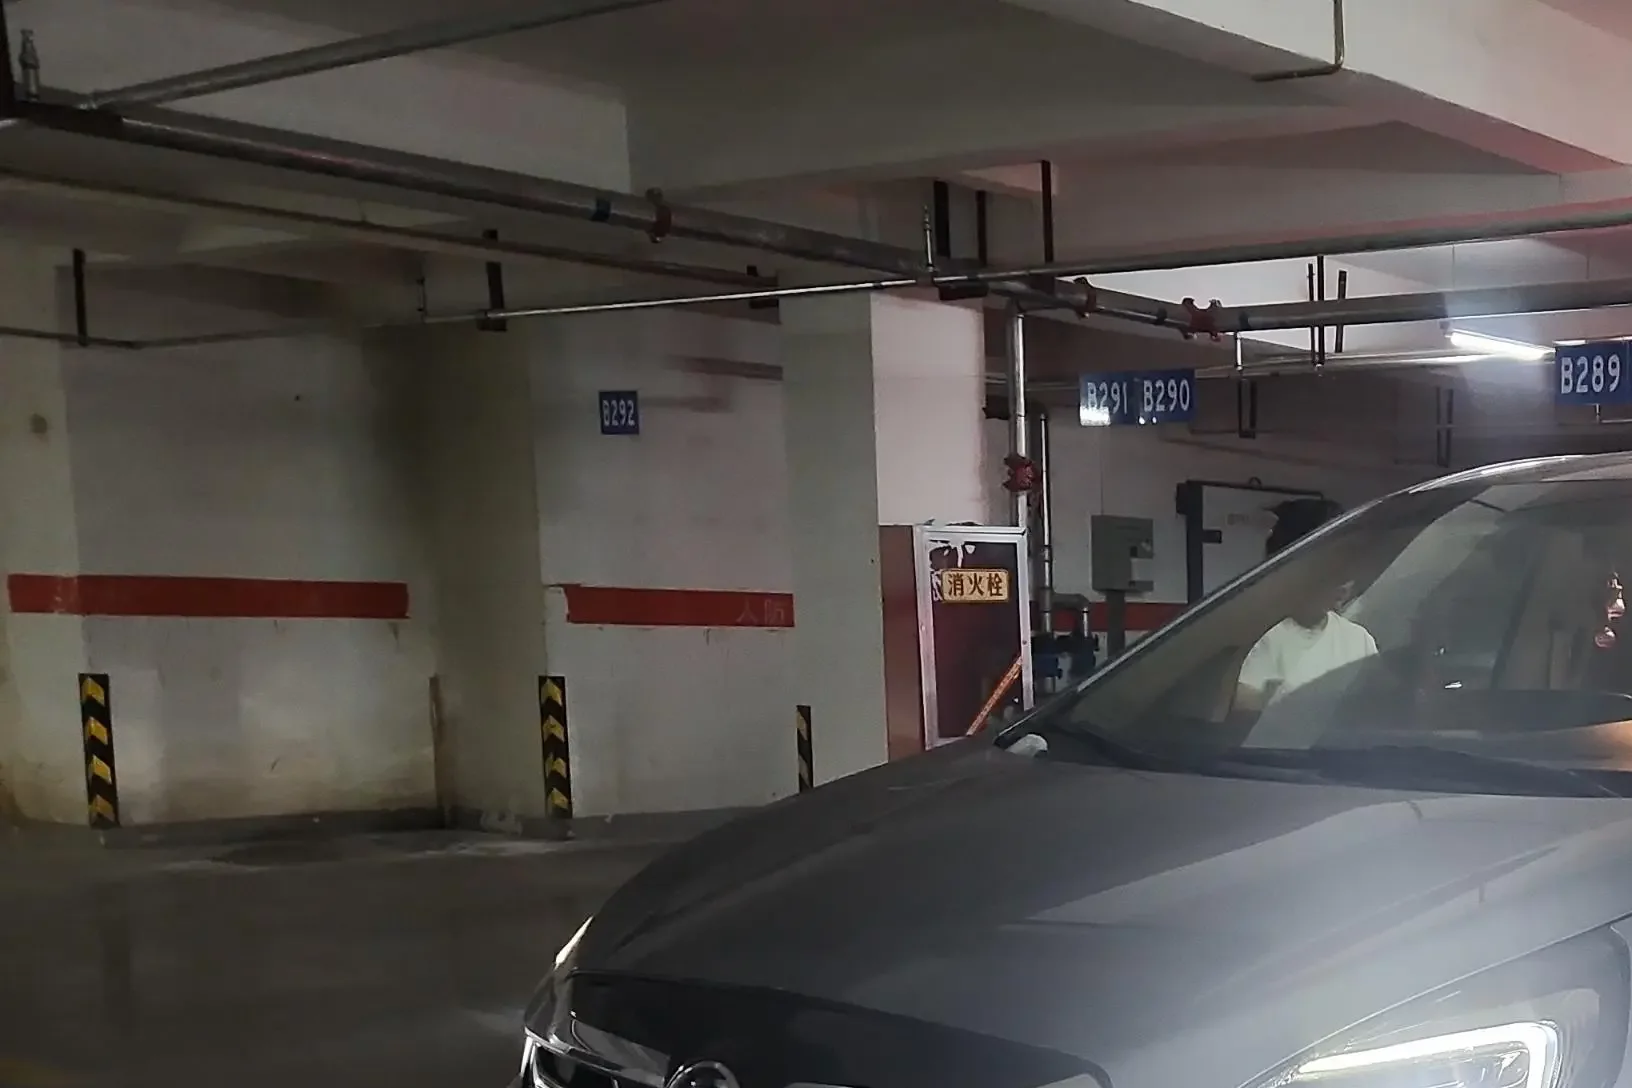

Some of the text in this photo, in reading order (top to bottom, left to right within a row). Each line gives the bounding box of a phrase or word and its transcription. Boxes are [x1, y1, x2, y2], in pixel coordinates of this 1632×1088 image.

[1560, 354, 1621, 394] B289
[1087, 381, 1128, 415] B291
[1143, 379, 1190, 412] B290
[602, 398, 636, 427] B292
[947, 572, 1004, 597] 消火栓
